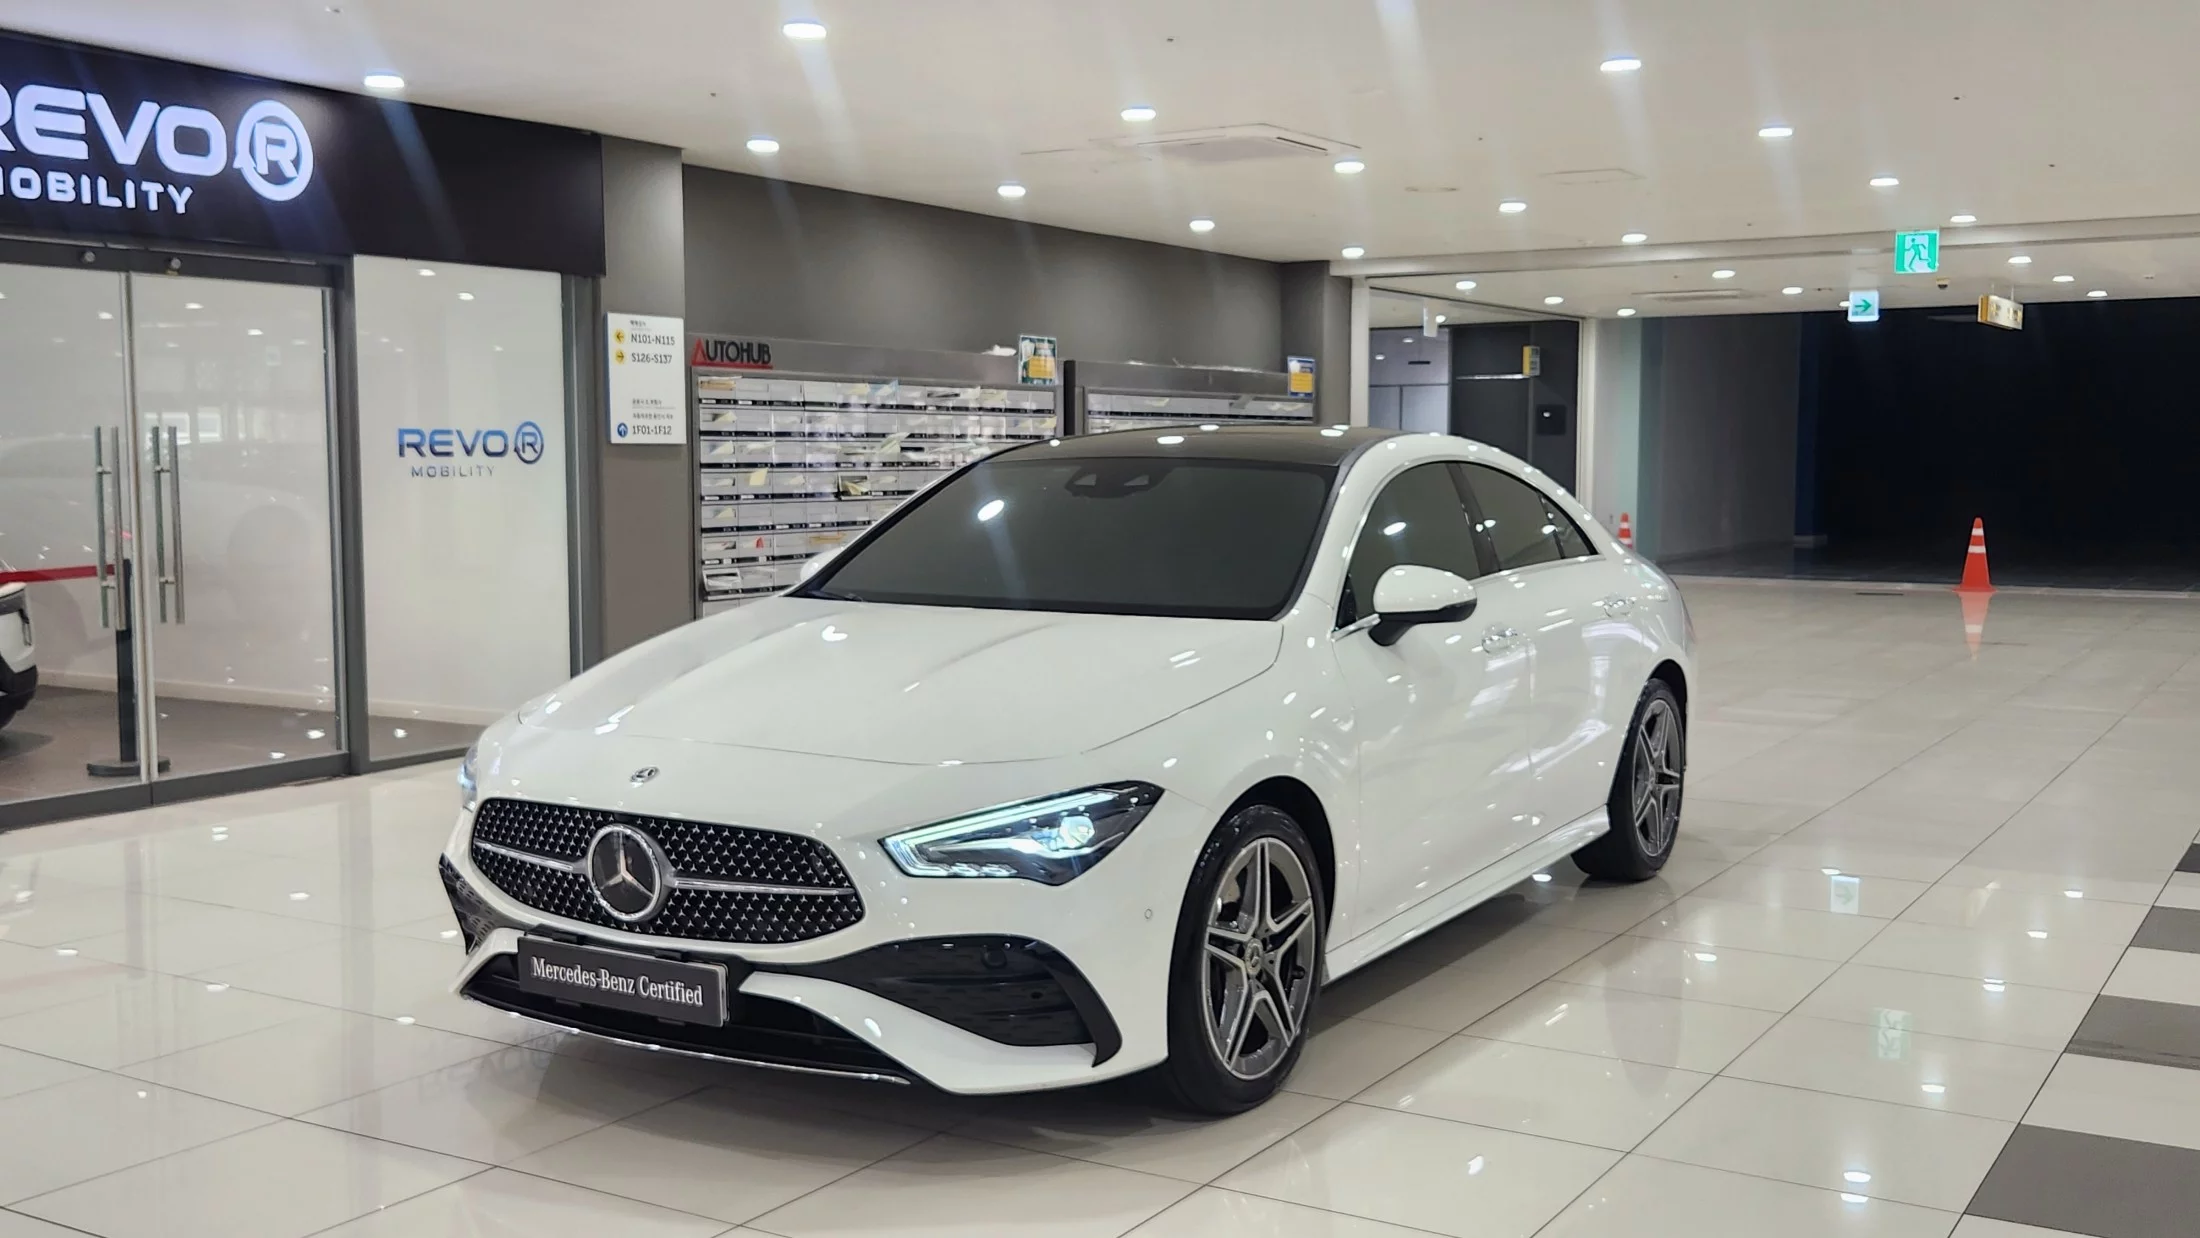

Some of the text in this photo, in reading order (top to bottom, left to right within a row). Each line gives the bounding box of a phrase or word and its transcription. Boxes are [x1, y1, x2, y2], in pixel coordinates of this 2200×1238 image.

[0, 83, 228, 177] EVO
[0, 166, 193, 214] OBILITY
[631, 333, 675, 346] N101-N115
[691, 337, 773, 366] AUTOHUB
[631, 352, 672, 364] S126-S137
[398, 428, 509, 457] REVO
[632, 425, 672, 435] 1F01-1F12
[411, 465, 495, 478] MOBILITY
[531, 956, 704, 1006] Mercedes-Benz Certified
